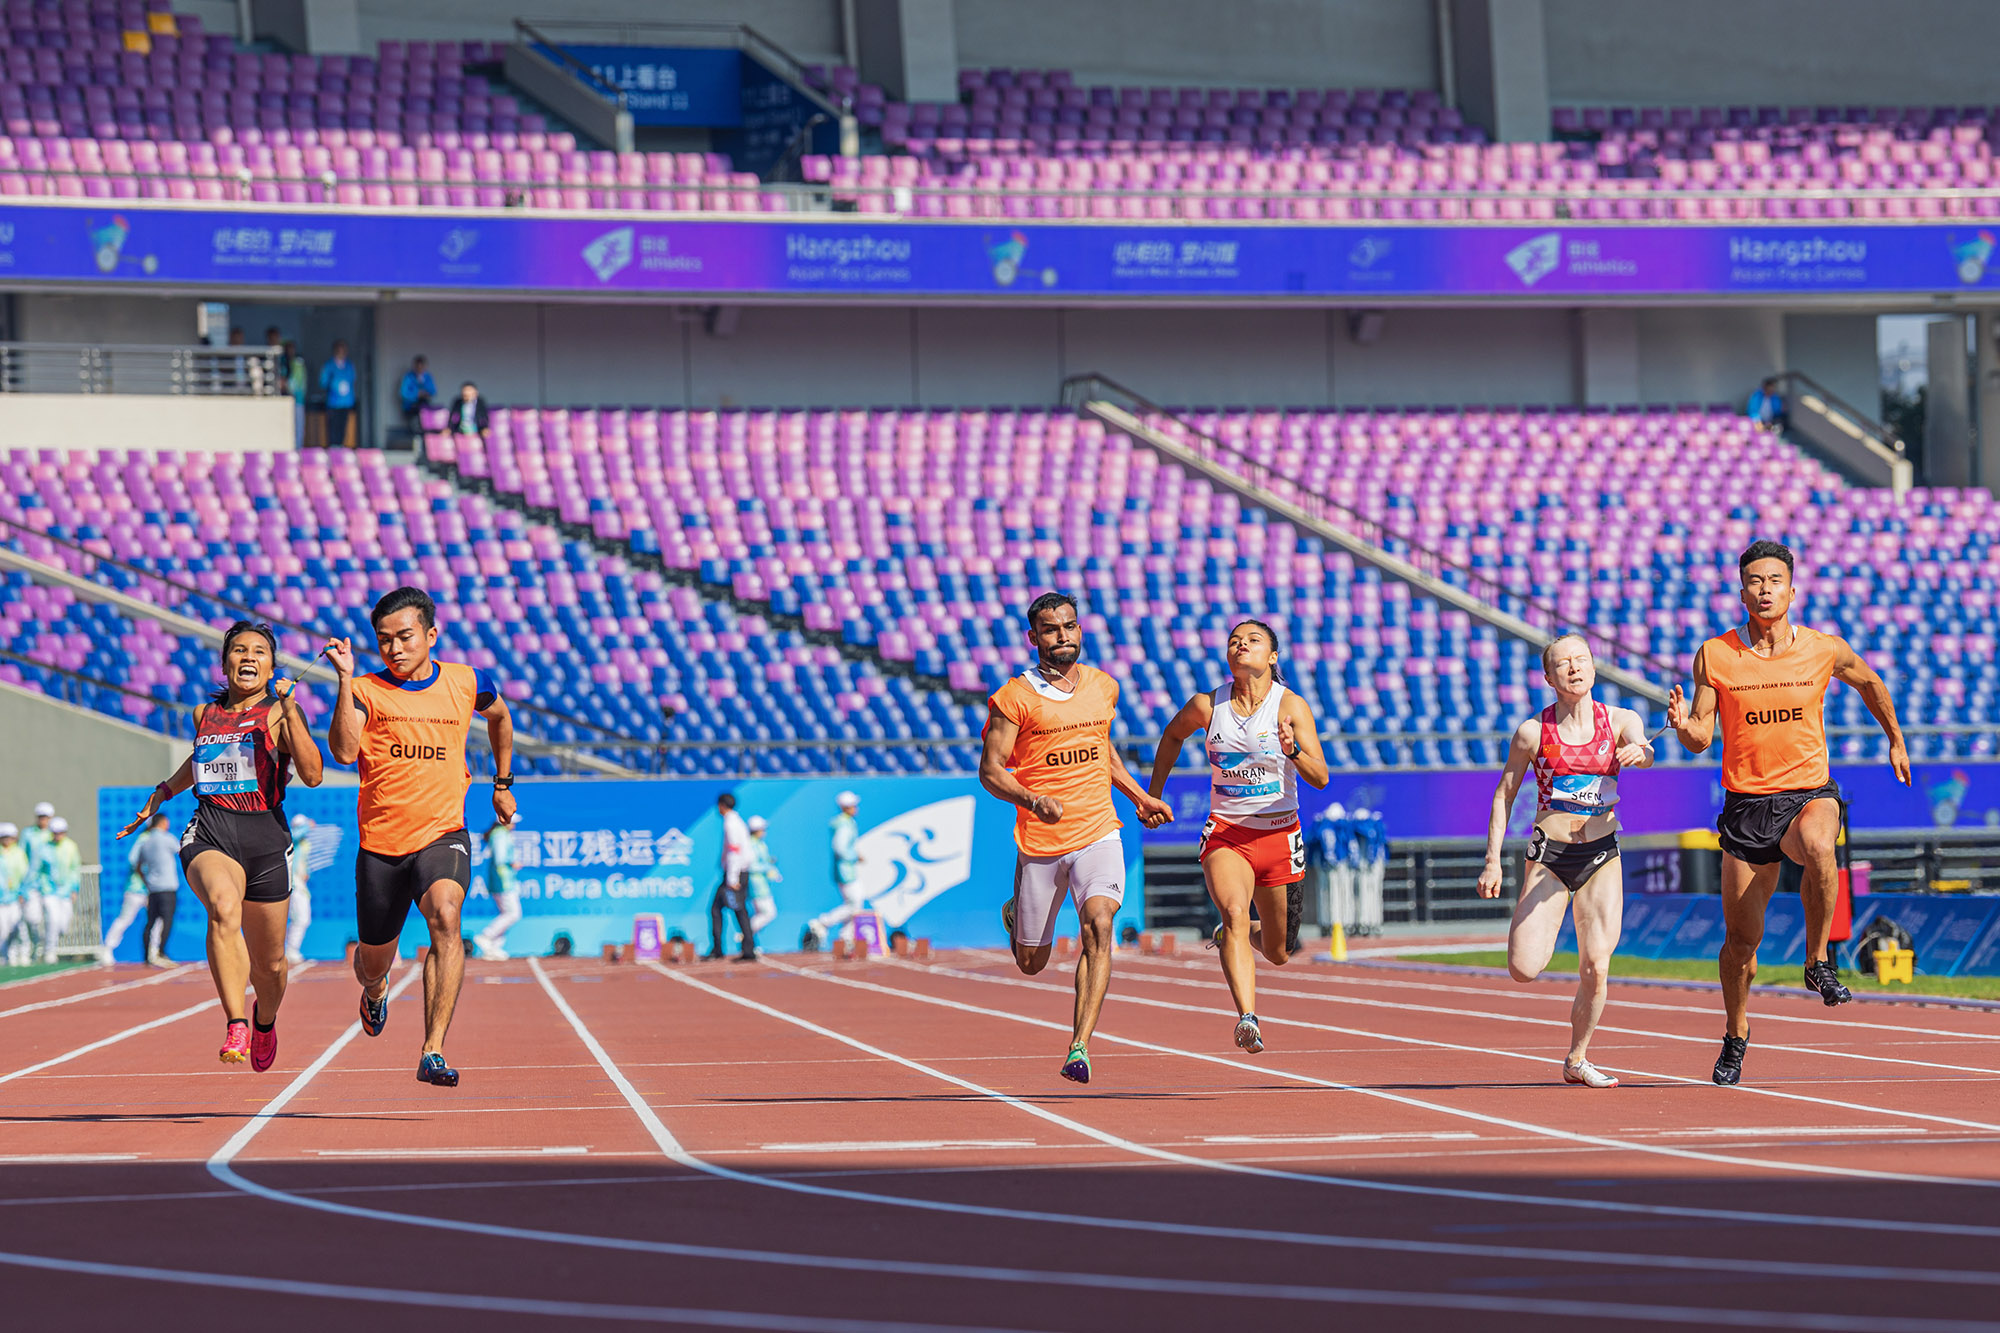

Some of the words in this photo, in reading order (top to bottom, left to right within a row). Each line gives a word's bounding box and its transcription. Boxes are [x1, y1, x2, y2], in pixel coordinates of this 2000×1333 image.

[786, 234, 911, 263] Hangzhou
[1730, 236, 1867, 265] Hangzhou
[442, 718, 460, 726] GAMES
[1745, 708, 1803, 725] GUIDE
[1031, 727, 1062, 736] HANGZHOU
[1063, 723, 1078, 732] ASIAN
[1079, 721, 1092, 729] PARA
[390, 744, 447, 760] GUIDE
[1046, 747, 1099, 766] GUIDE
[204, 763, 238, 774] PUTRI
[1221, 767, 1266, 779] SIMRAN
[225, 773, 237, 781] 237
[221, 783, 245, 792] LEVC
[1571, 791, 1602, 801] SHEN
[1270, 815, 1290, 827] NIKE
[471, 828, 695, 868] 届亚残运会
[544, 873, 602, 899] Para
[606, 873, 695, 899] Games
